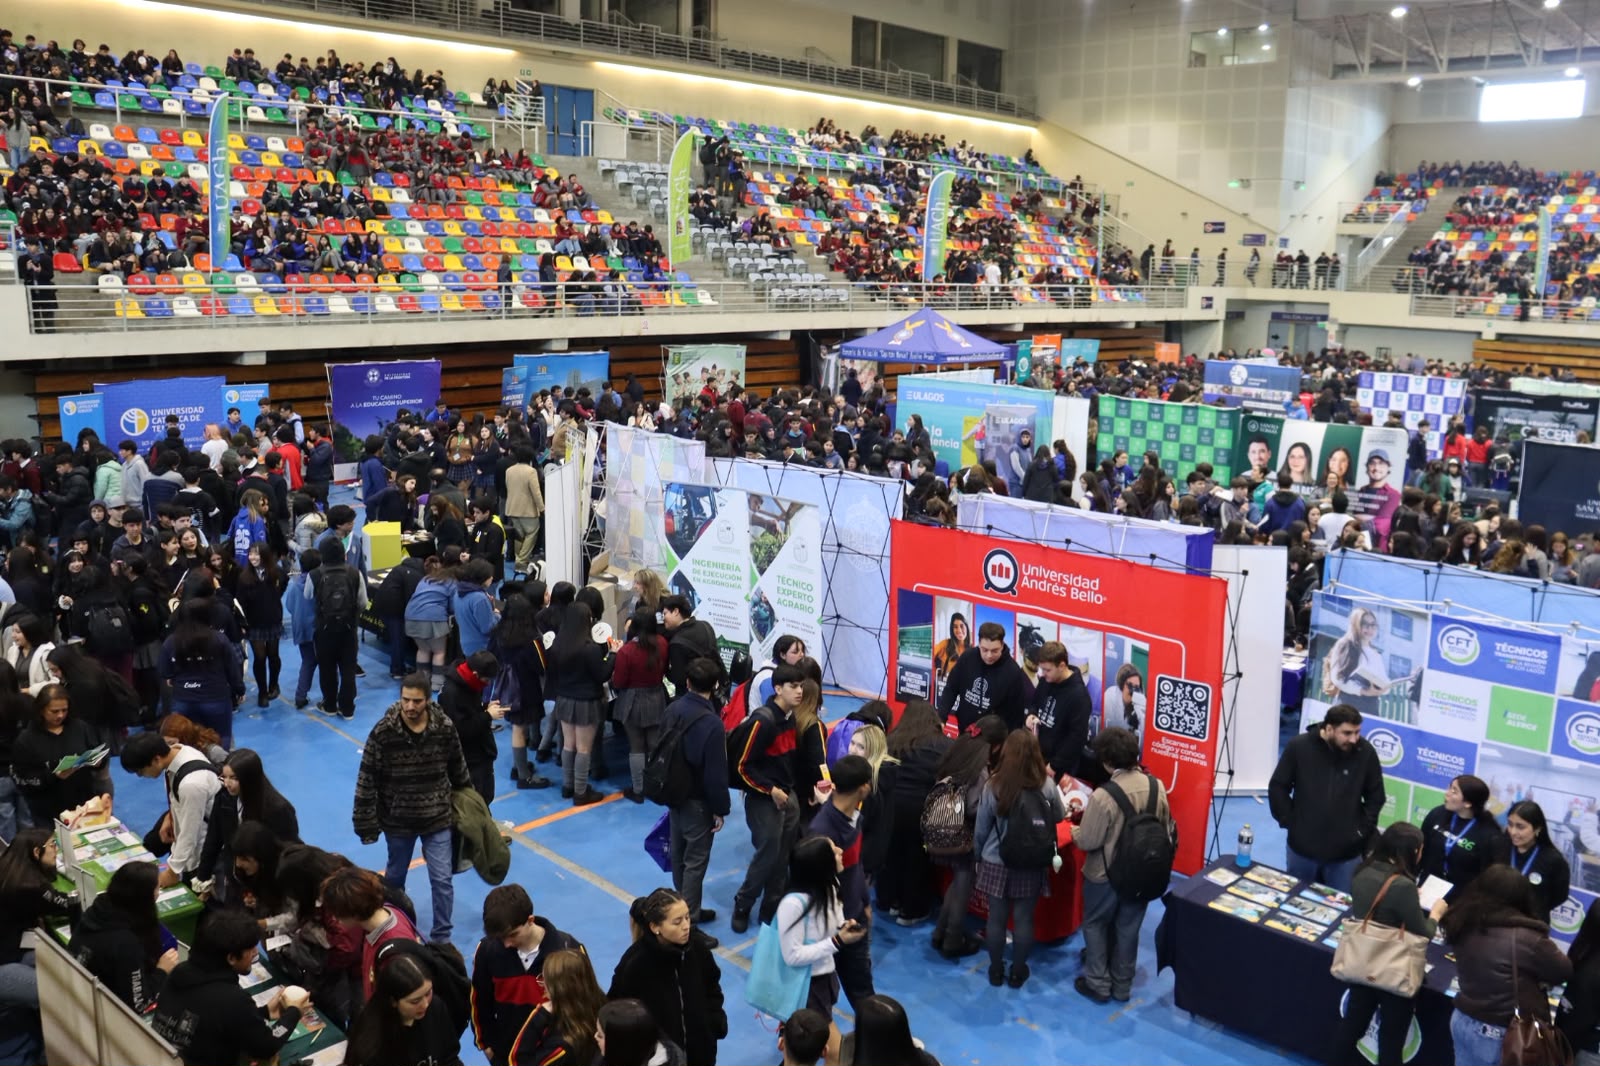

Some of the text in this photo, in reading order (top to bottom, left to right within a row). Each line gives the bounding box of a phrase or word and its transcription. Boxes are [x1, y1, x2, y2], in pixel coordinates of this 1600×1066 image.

[930, 198, 945, 242] UACh
[363, 399, 396, 407] EDUCACIÓN
[913, 391, 945, 402] ULAGOS
[151, 406, 205, 416] UNIVERSIDAD
[190, 414, 201, 422] DE
[692, 558, 741, 573] INGENIERÍA
[692, 567, 743, 582] DE EJECUCIÓN
[1021, 563, 1100, 591] Universidad
[702, 578, 743, 590] AGRONOMÍA
[776, 574, 814, 592] TÉCNICO
[1021, 575, 1104, 605] Andrés Bello
[776, 586, 814, 603] EXPERTO
[776, 599, 815, 614] AGRARIO
[1446, 634, 1472, 648] CFT
[1495, 642, 1548, 659] TÉCNICOS
[1430, 690, 1479, 706] TÉCNICOS
[1372, 738, 1397, 751] CFT
[1417, 747, 1465, 764] TÉCNICOS
